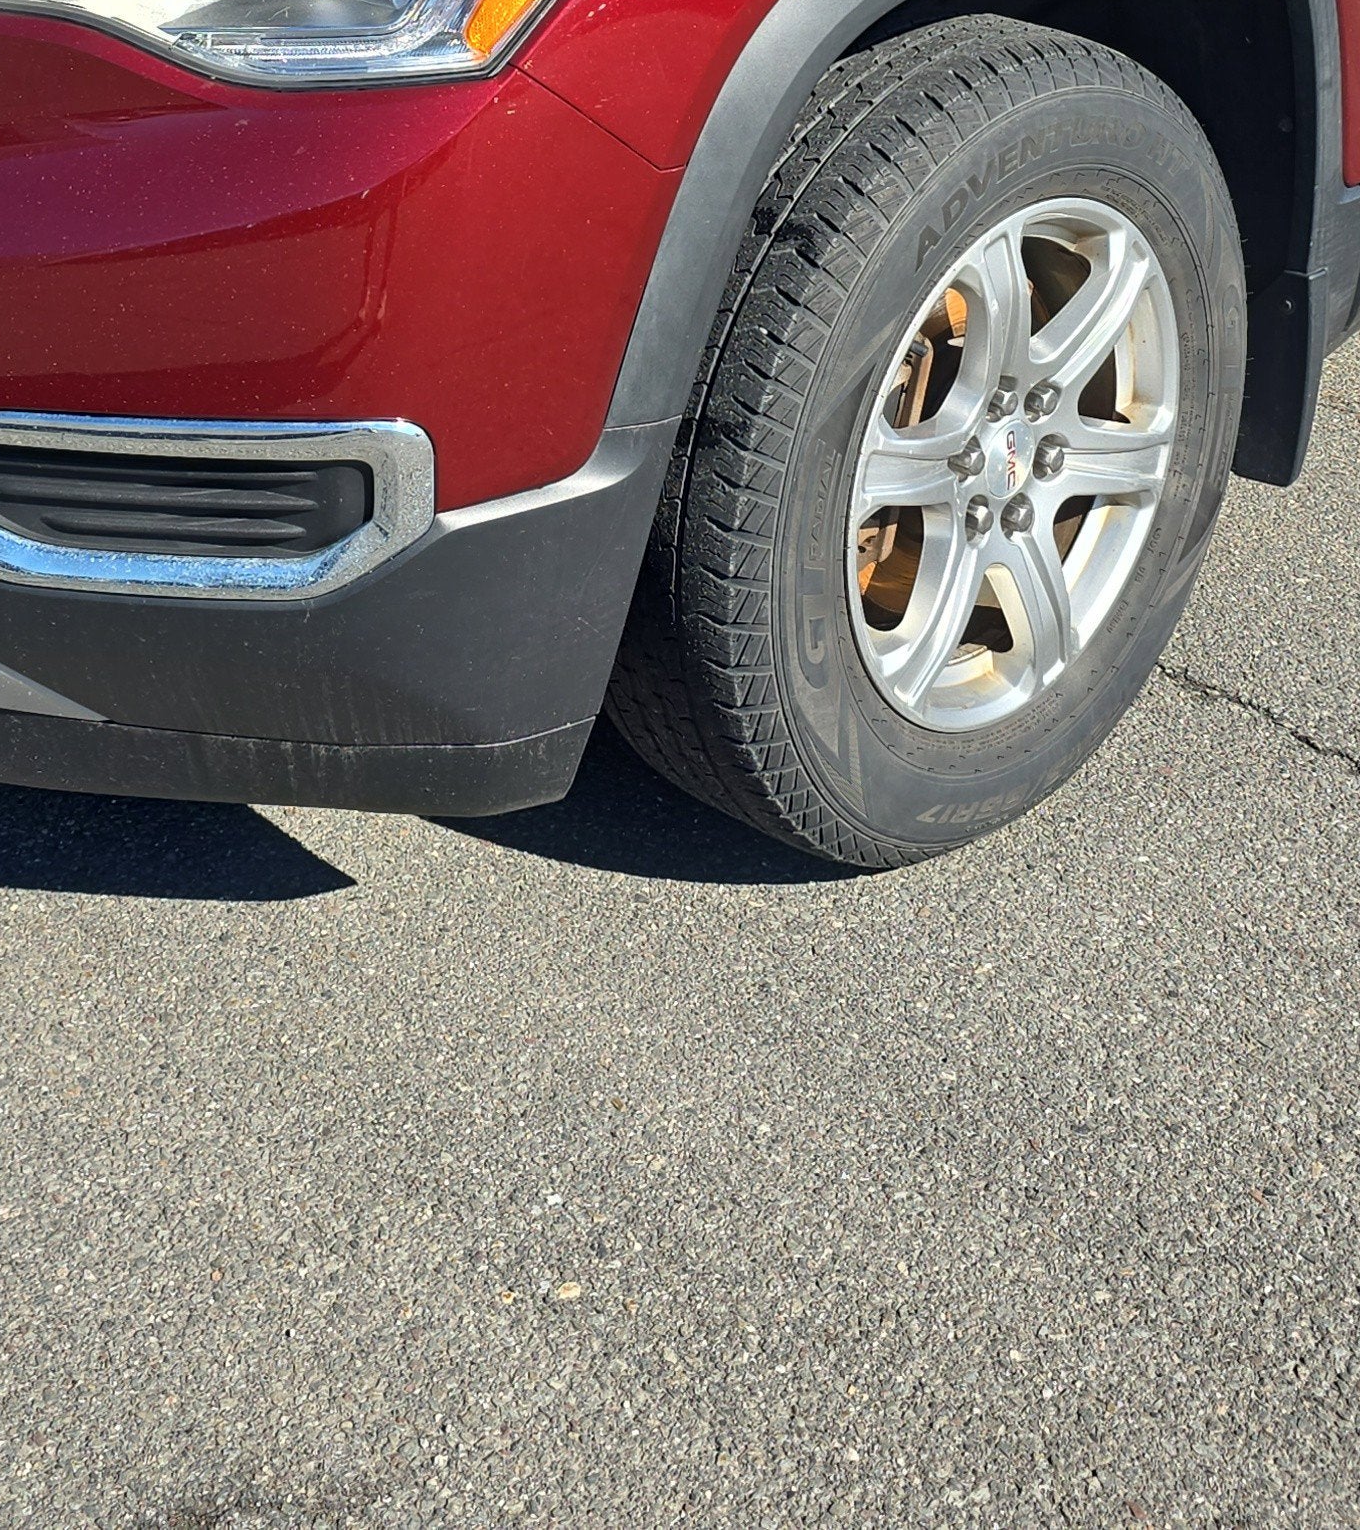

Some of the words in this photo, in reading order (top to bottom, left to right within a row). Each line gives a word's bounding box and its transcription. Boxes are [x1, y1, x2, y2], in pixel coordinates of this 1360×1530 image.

[915, 119, 1147, 276] ADVENTURO
[809, 448, 837, 562] RADIAL
[1006, 430, 1016, 490] GMC
